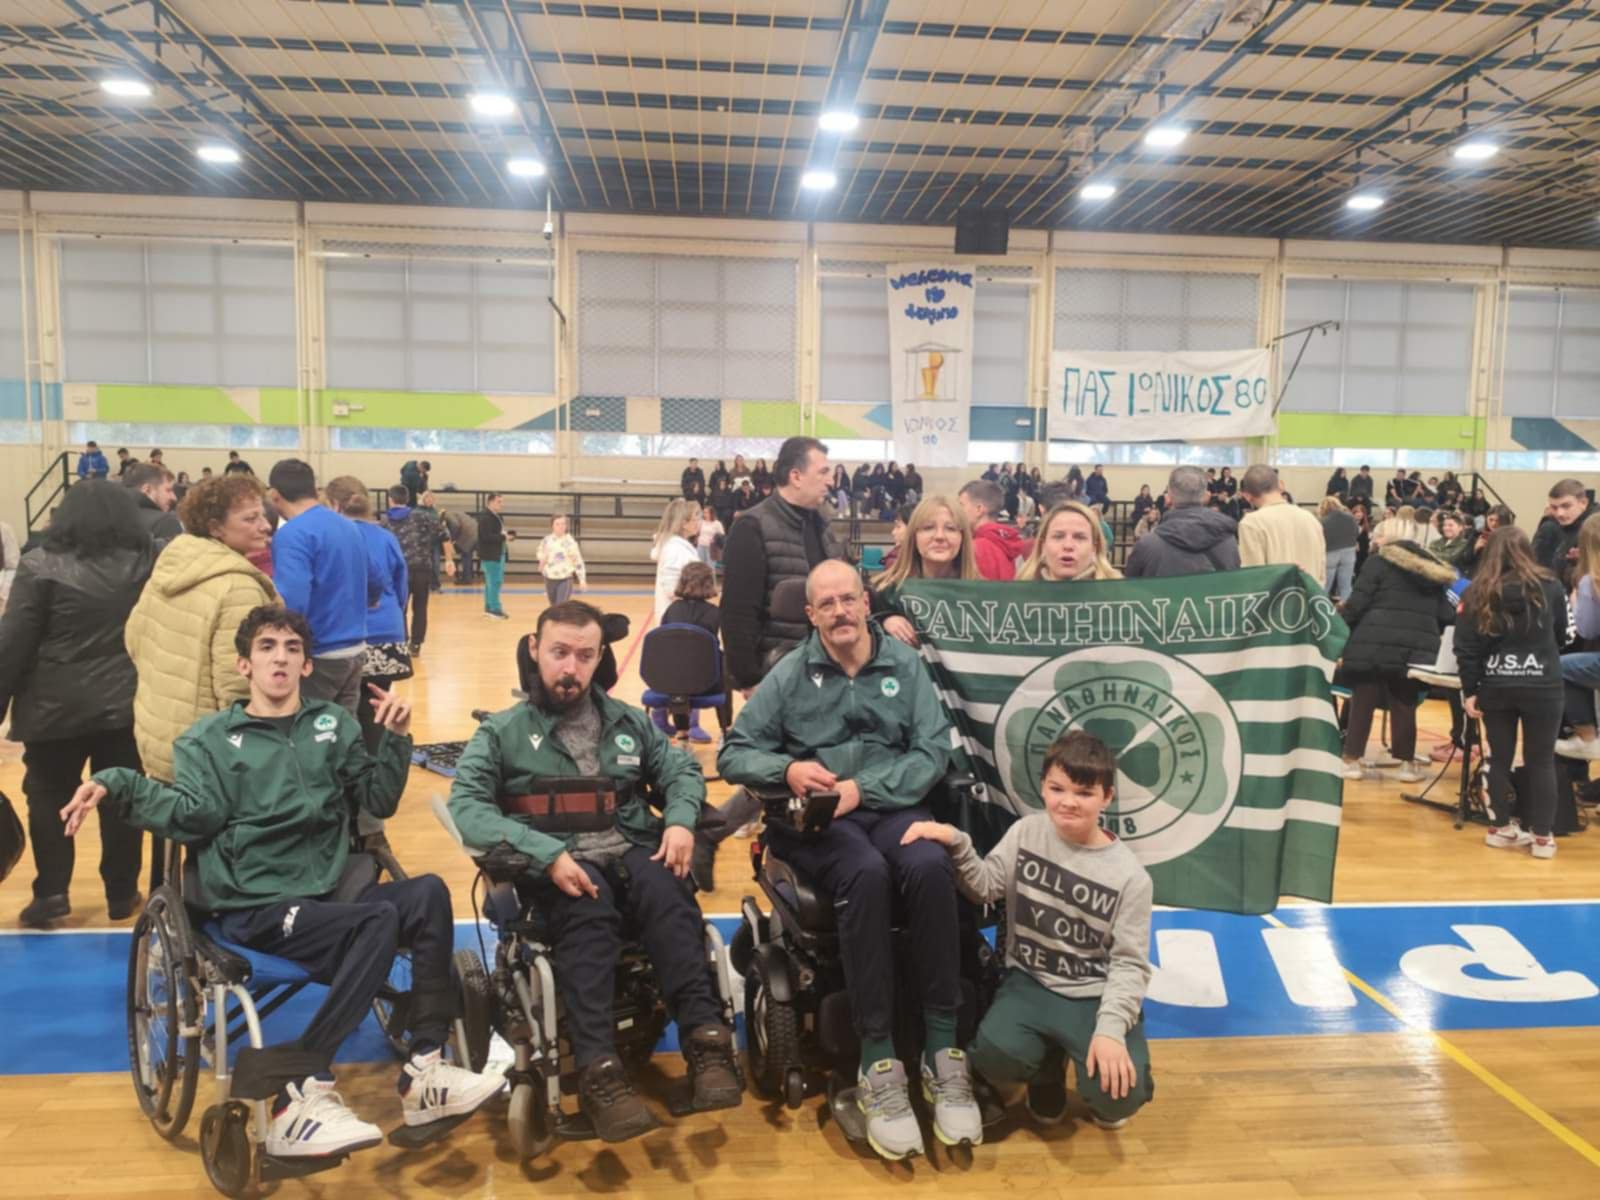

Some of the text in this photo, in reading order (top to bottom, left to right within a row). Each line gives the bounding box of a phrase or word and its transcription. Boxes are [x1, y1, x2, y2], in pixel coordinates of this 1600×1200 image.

[1063, 367, 1117, 416] ΠΑΣ
[1234, 377, 1267, 409] 80
[901, 586, 1336, 645] PANATHINAIKOS
[1487, 653, 1544, 669] U.S.A.
